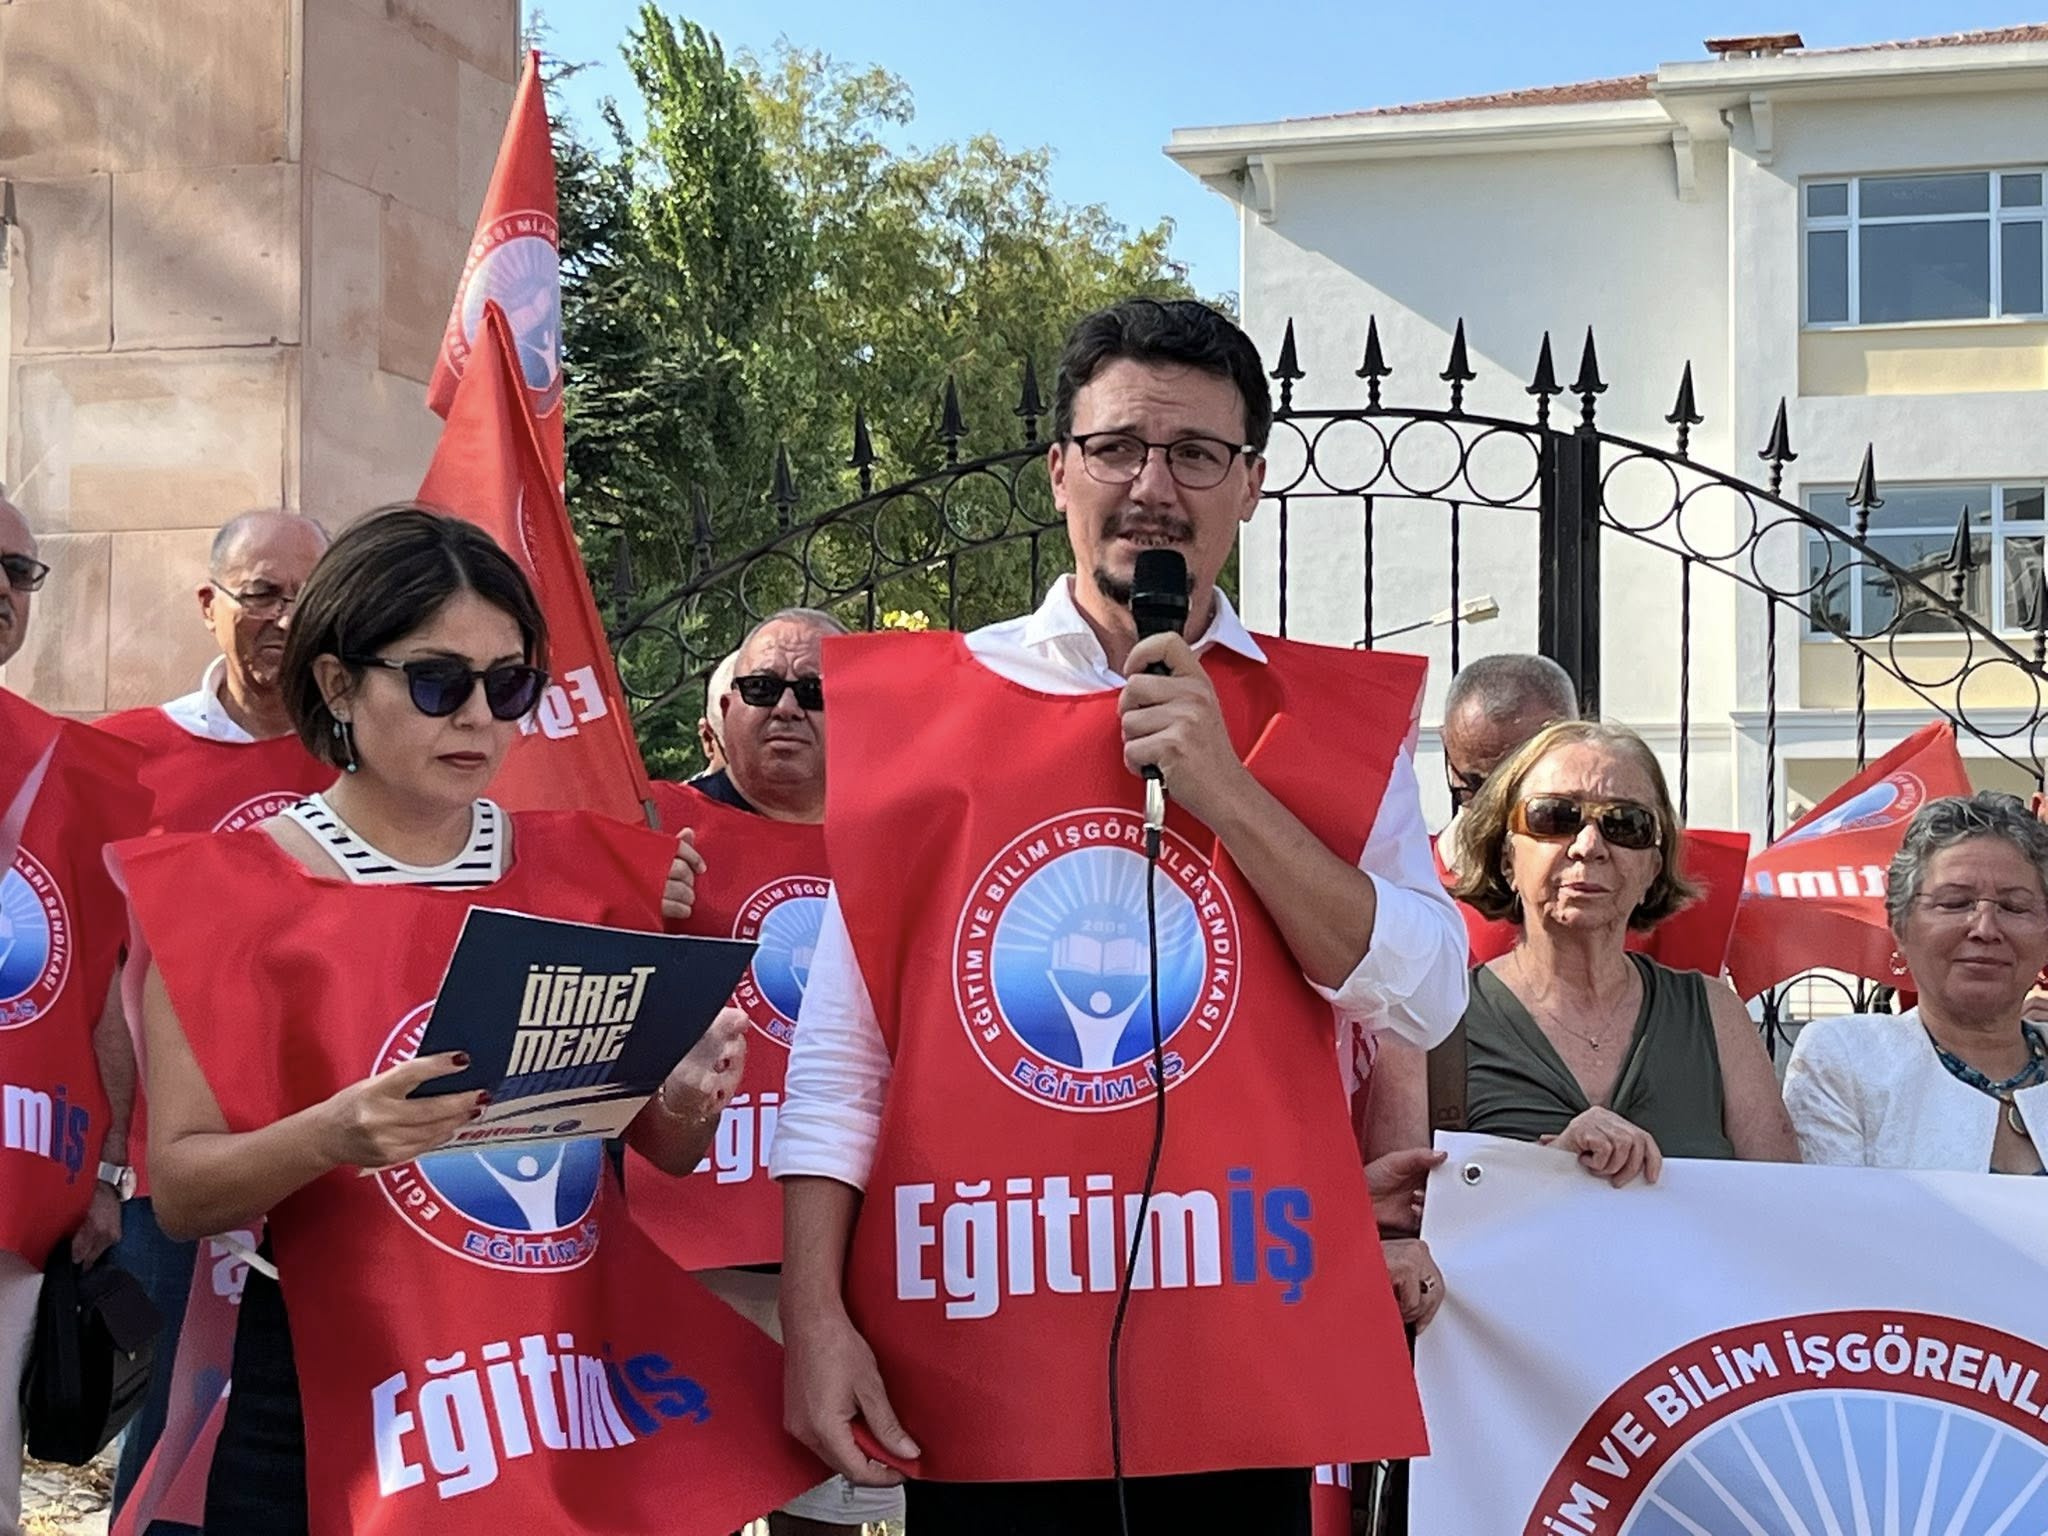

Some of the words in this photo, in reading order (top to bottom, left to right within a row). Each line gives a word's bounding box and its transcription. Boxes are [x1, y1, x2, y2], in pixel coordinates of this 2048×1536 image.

[985, 838, 1050, 903] BİLİM
[747, 887, 786, 922] BİLİM
[968, 905, 994, 940] VE
[1197, 888, 1235, 1032] SENDİKASI
[517, 963, 657, 1028] ÖĞRET
[962, 949, 1002, 1043] EĞİTİM
[1585, 1411, 1657, 1479] VE
[1643, 1341, 1780, 1428] BİLİM
[1783, 1324, 2048, 1424] İŞGÖRENL
